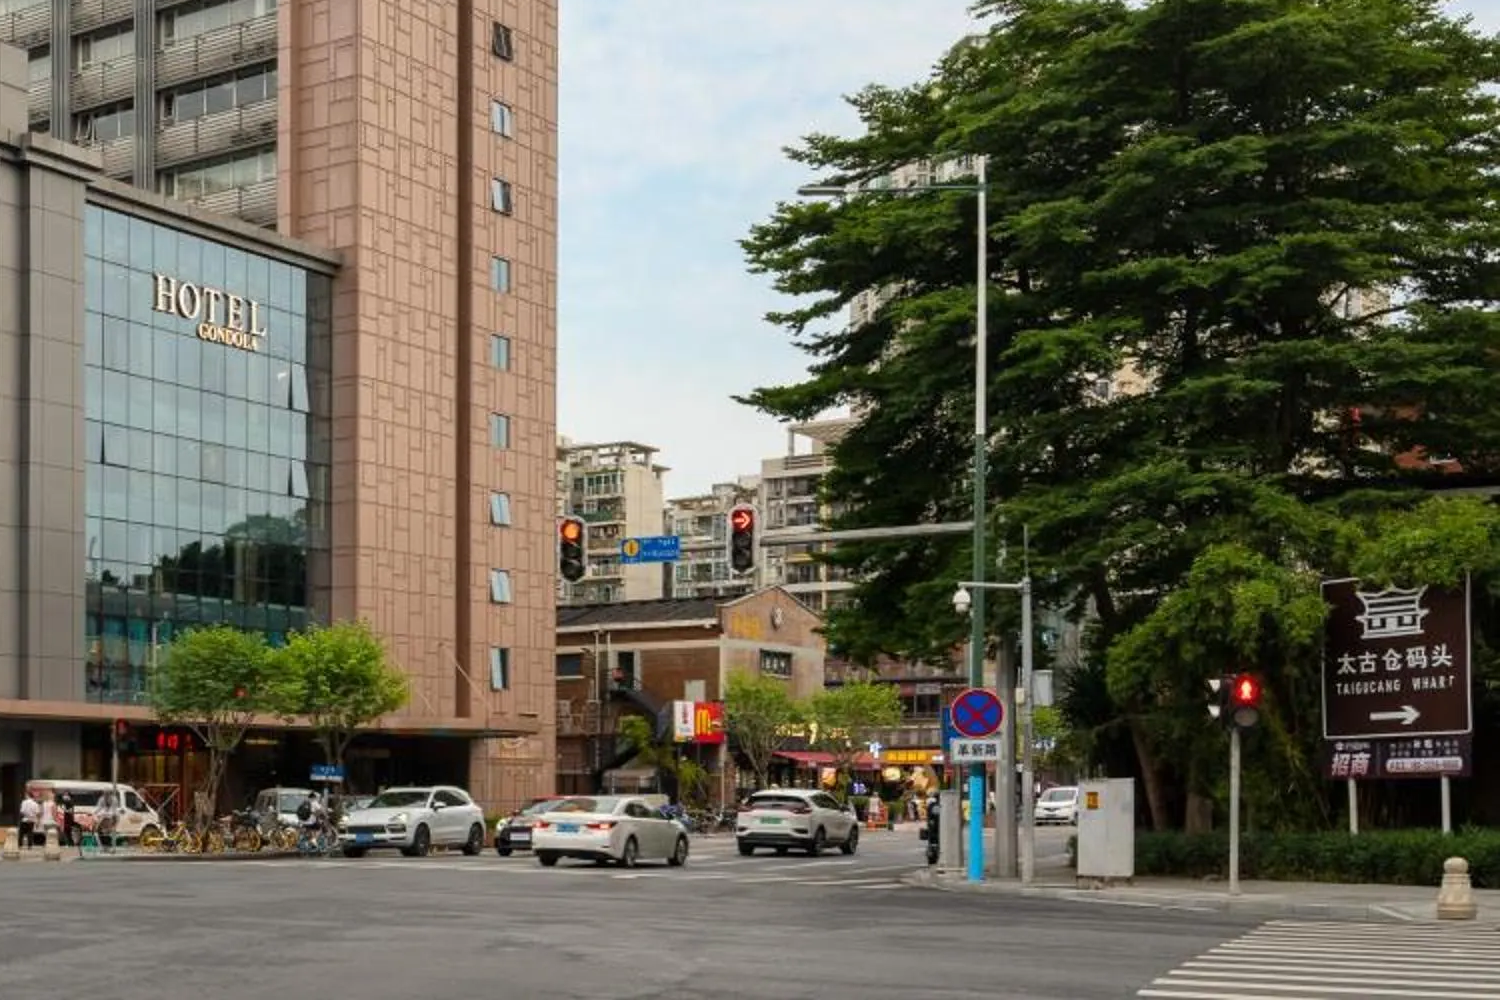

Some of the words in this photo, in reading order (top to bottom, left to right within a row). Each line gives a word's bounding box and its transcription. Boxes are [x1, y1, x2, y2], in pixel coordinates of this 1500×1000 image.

[153, 273, 267, 337] HOTEL
[197, 323, 258, 351] GONDOLA
[1337, 643, 1453, 675] 太古仓码头
[1331, 752, 1371, 776] 招商
